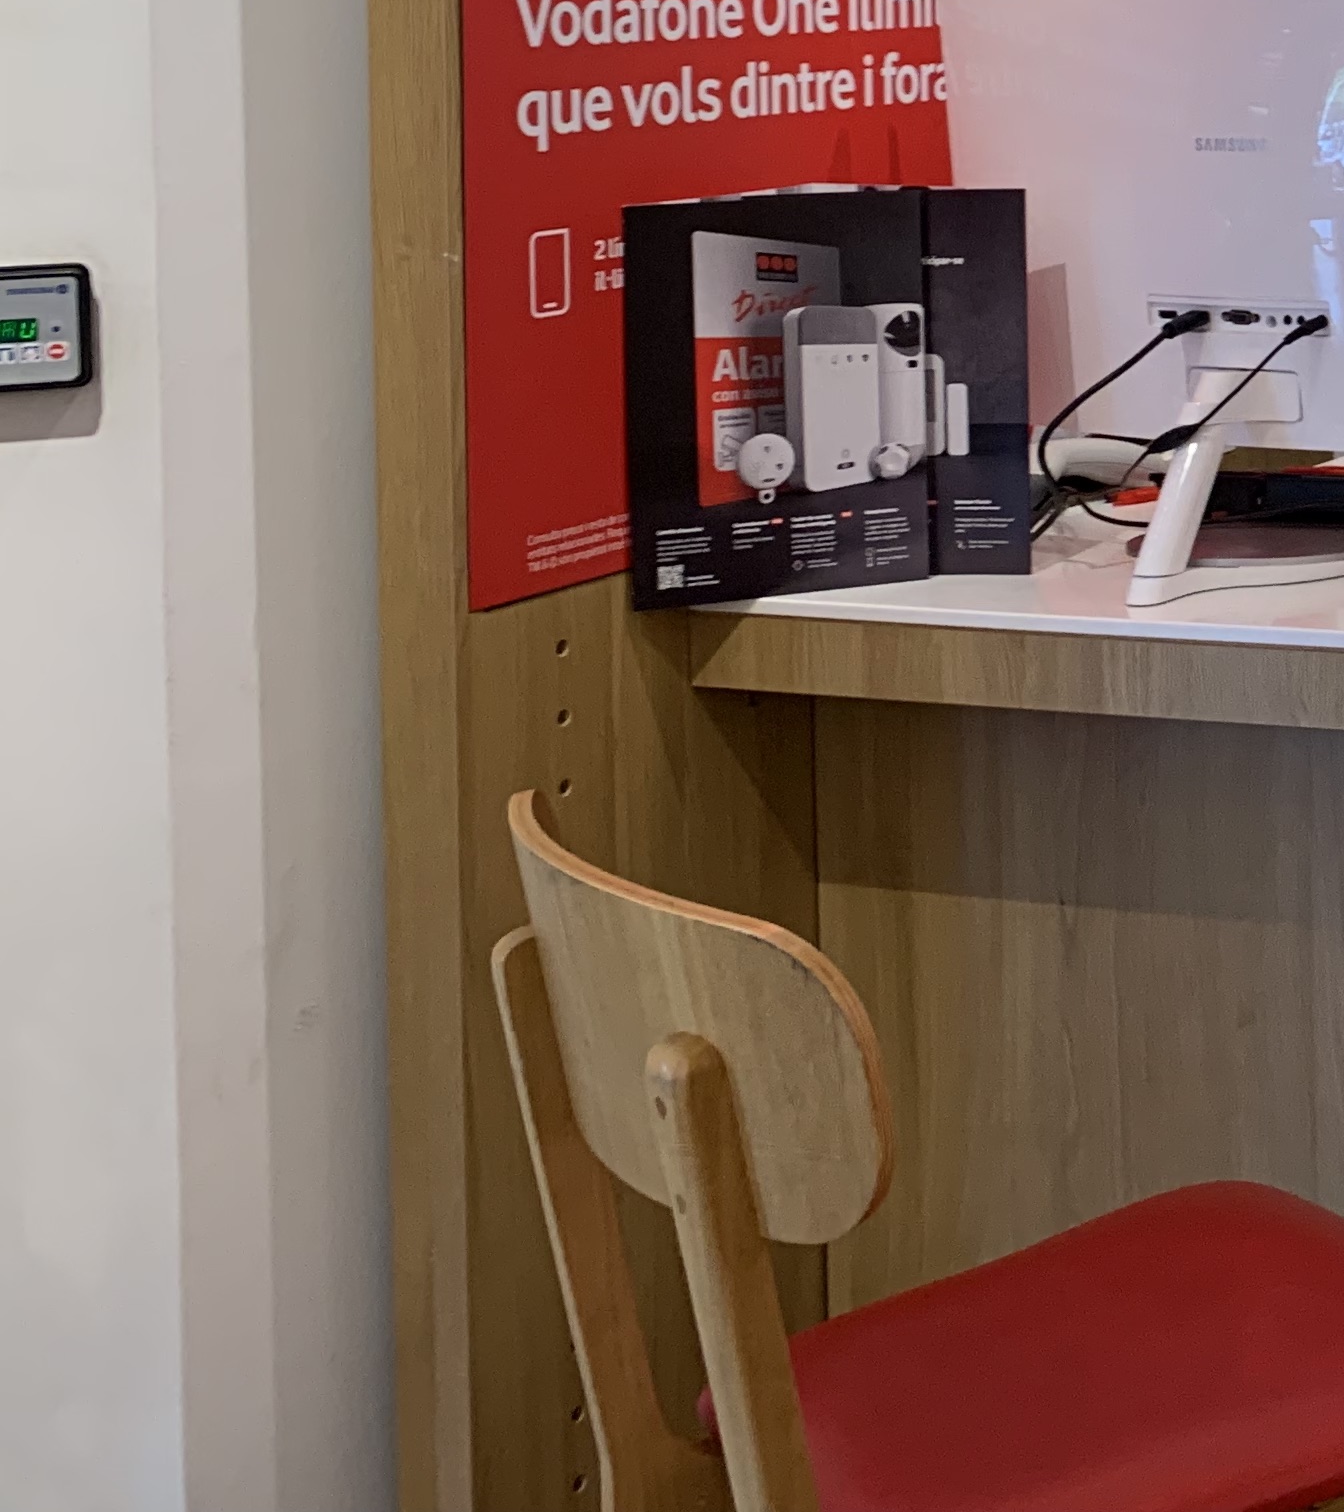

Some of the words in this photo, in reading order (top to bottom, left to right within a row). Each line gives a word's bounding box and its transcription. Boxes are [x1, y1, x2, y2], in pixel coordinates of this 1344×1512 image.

[516, 86, 614, 152] que
[621, 65, 723, 127] vols
[730, 61, 857, 119] dintre
[862, 54, 876, 108] i
